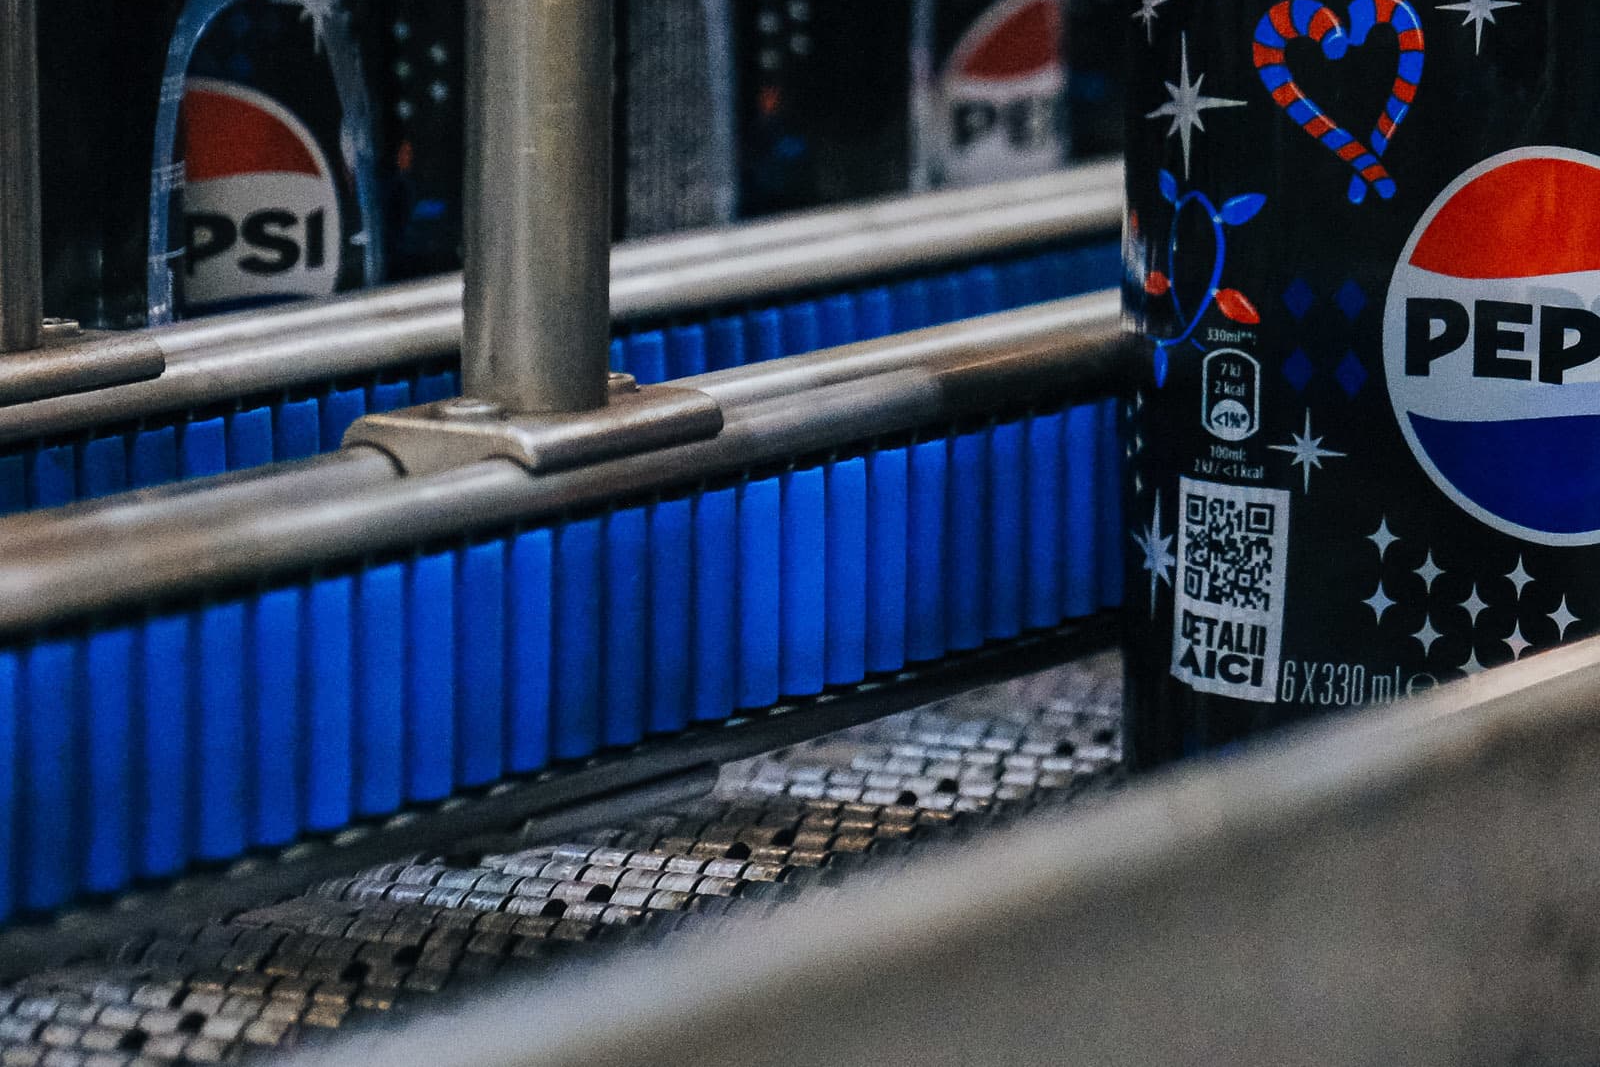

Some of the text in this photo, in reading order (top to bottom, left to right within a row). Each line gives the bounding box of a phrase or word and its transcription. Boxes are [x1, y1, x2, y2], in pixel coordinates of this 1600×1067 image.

[1214, 382, 1246, 396] 2 kcal
[1240, 465, 1264, 479] kcal
[1181, 608, 1267, 657] DETALII
[1178, 643, 1264, 688] AICI
